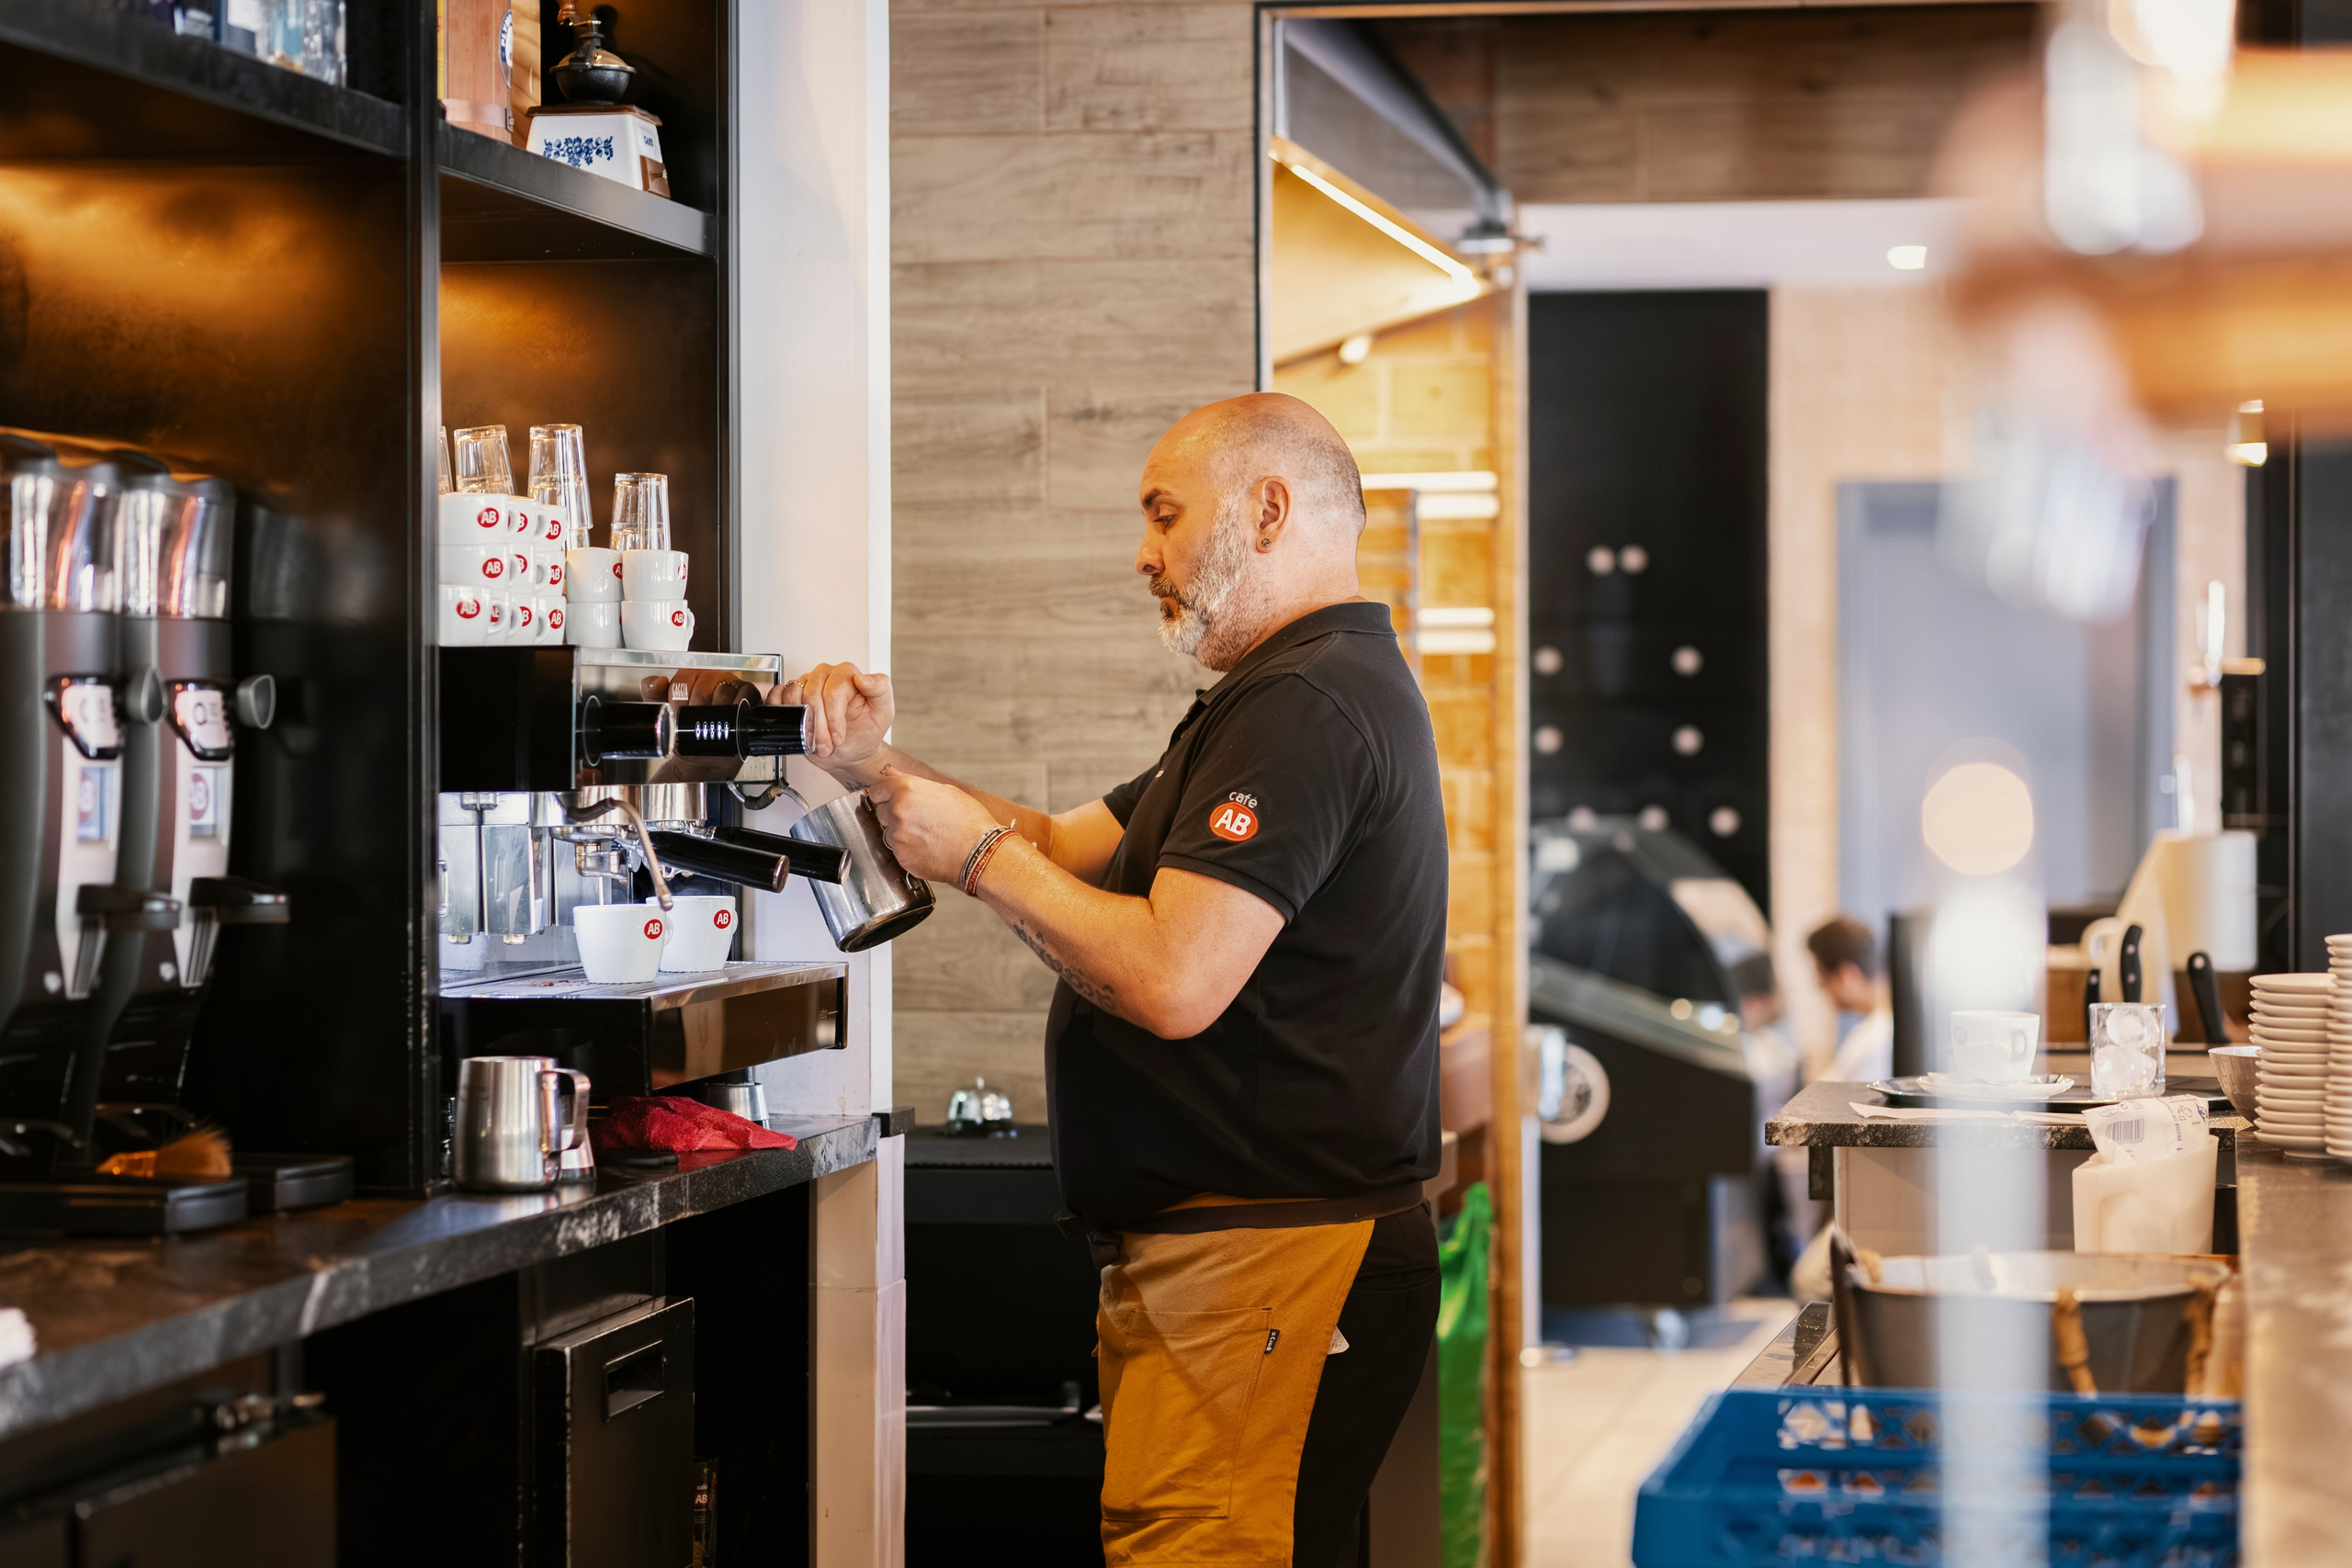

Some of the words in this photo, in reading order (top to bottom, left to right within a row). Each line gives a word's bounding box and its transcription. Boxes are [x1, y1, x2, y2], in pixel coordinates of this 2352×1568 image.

[481, 511, 497, 525] AB
[485, 560, 502, 574] AB
[615, 565, 622, 575] A
[460, 601, 478, 615] AB
[522, 609, 530, 623] B
[551, 612, 561, 625] AB
[673, 613, 684, 624] AB
[1229, 792, 1258, 808] café
[1215, 808, 1251, 835] AB
[717, 913, 729, 924] AB
[647, 922, 660, 935] AB
[695, 1495, 707, 1504] AB
